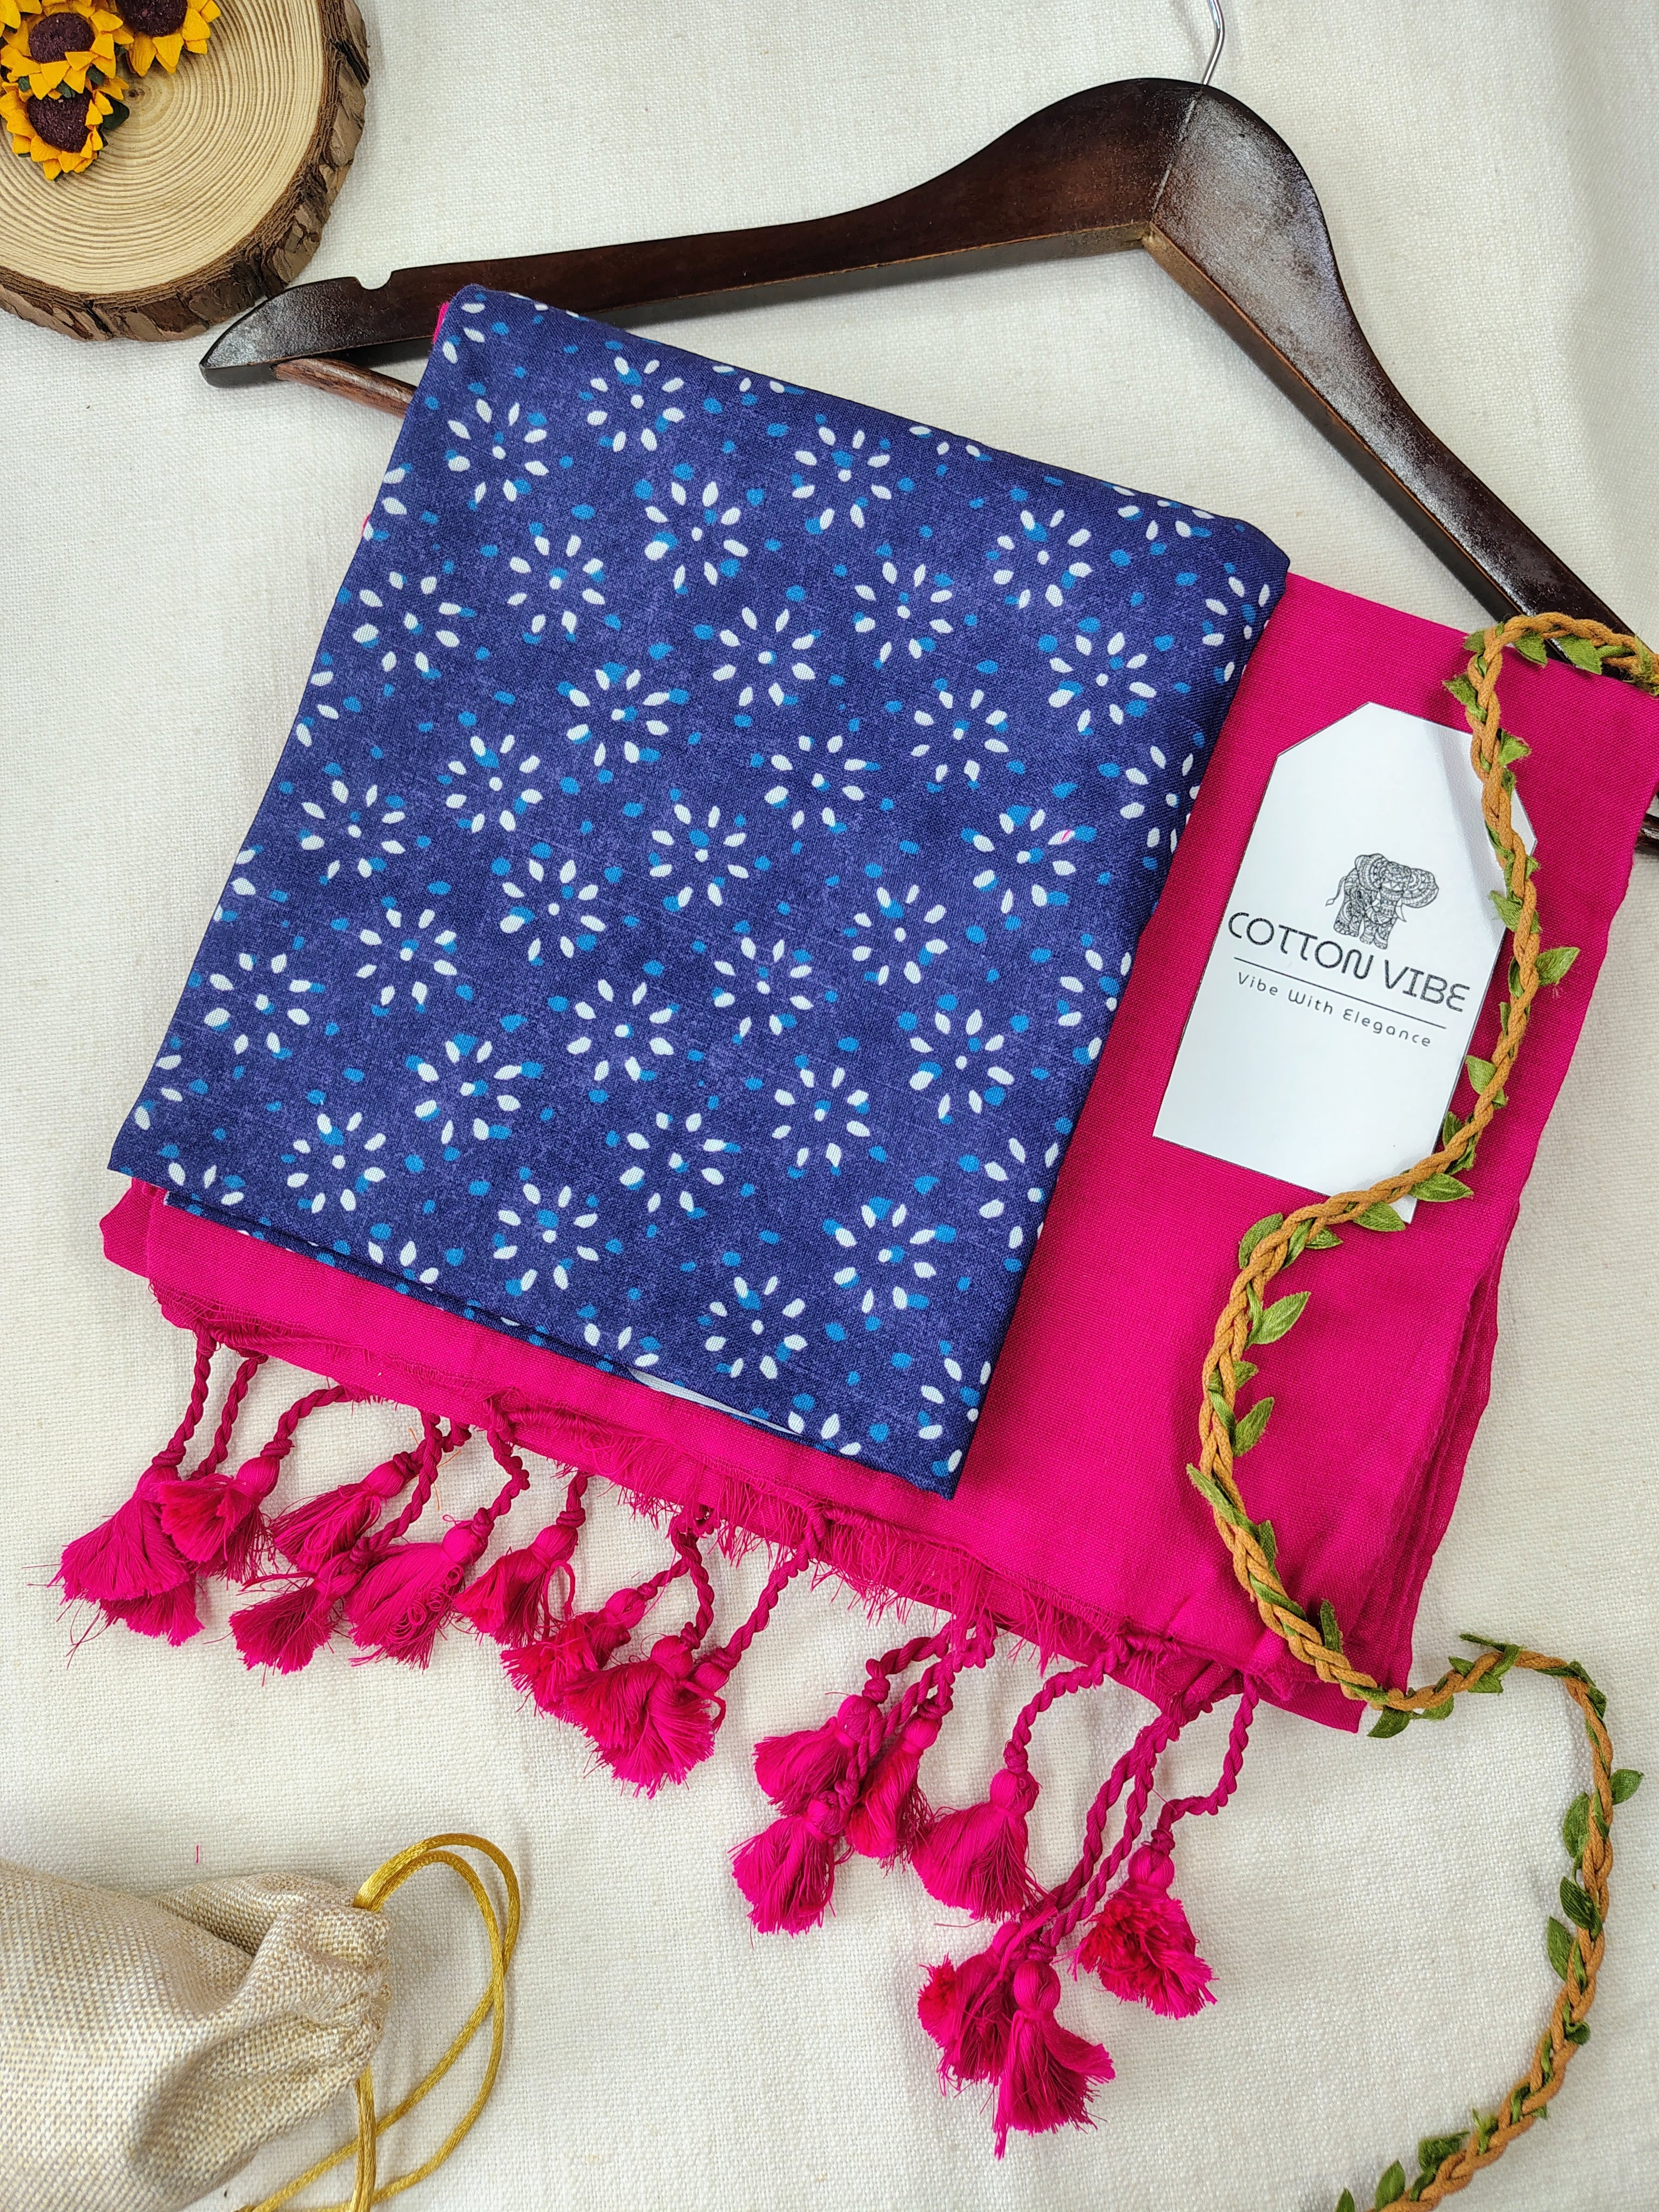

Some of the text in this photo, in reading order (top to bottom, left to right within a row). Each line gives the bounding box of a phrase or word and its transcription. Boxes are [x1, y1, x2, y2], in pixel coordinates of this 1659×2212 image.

[1228, 912, 1471, 1013] COTTON VIBE
[1237, 972, 1431, 1047] Vibe With Elegance
